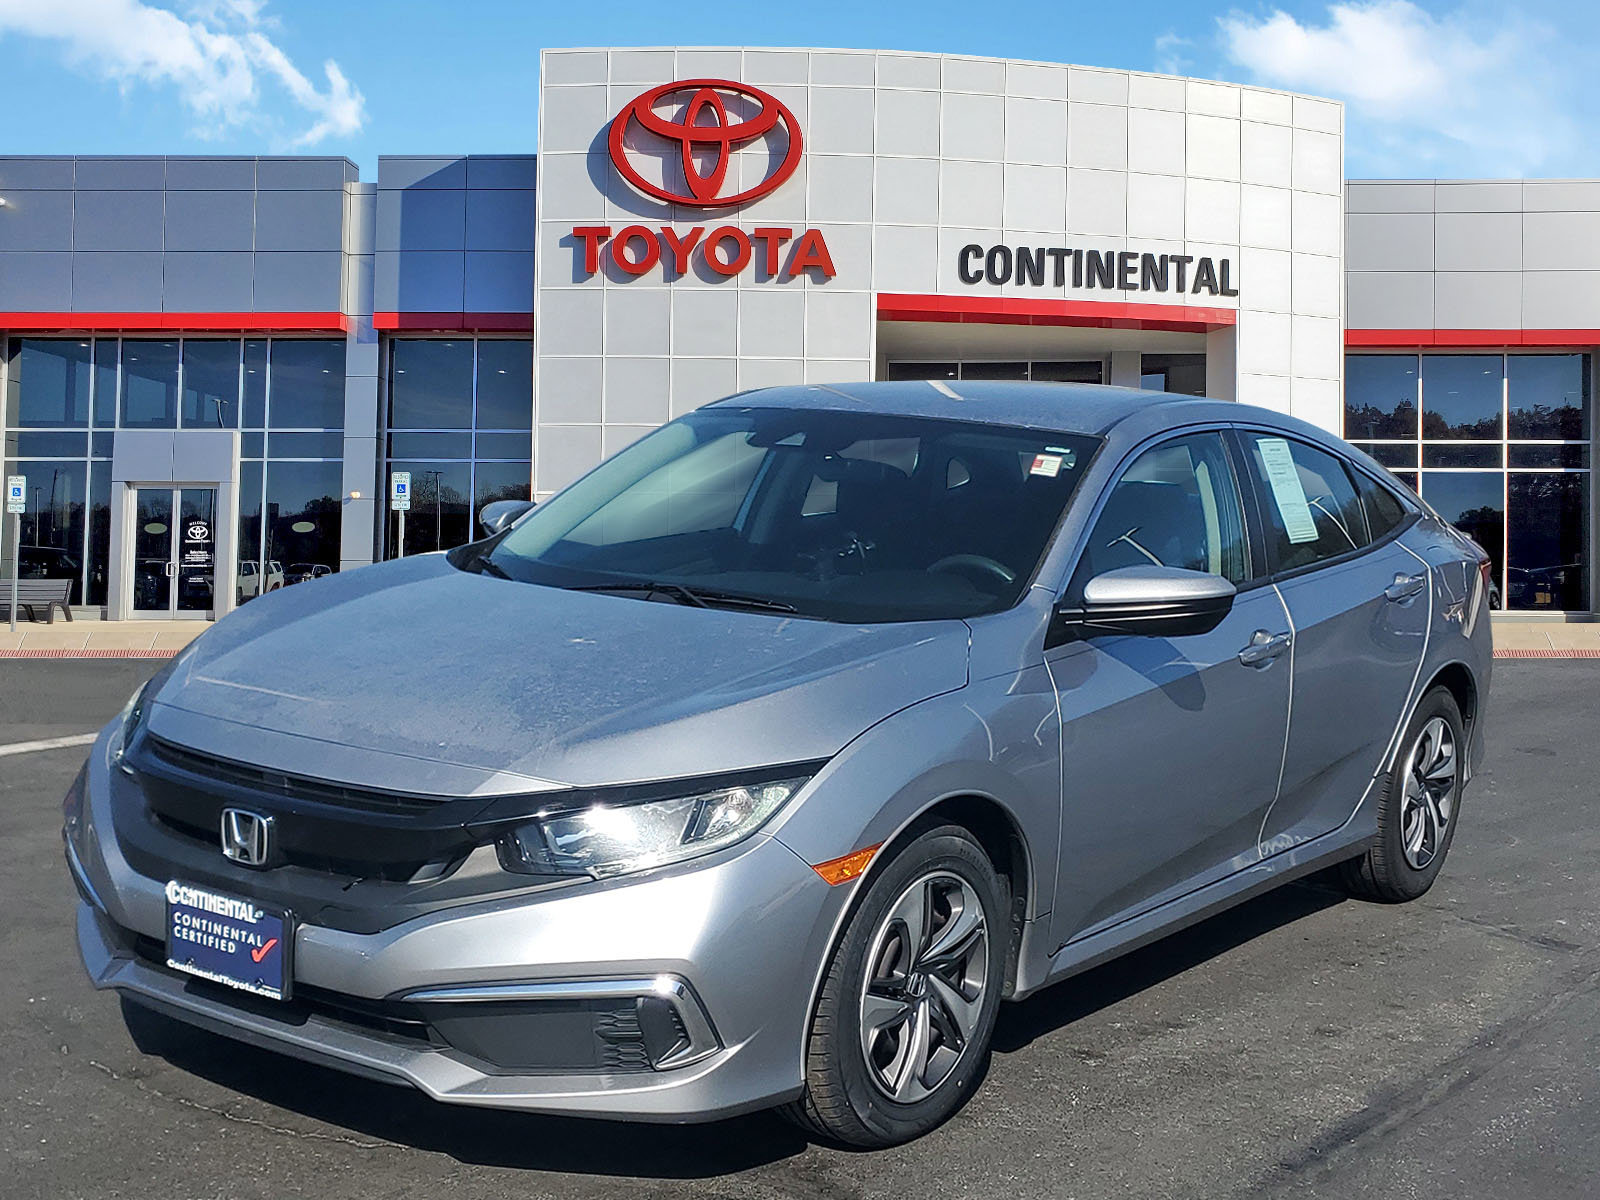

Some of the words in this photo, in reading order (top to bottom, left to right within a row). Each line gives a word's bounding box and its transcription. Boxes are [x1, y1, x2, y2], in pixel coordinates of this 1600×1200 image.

[572, 225, 837, 277] TOYOTA
[958, 244, 1238, 296] CONTINENTAL
[165, 880, 257, 924] CONTINENTAL
[174, 912, 263, 947] CONTINENTAL
[174, 926, 236, 954] CERTIFIED
